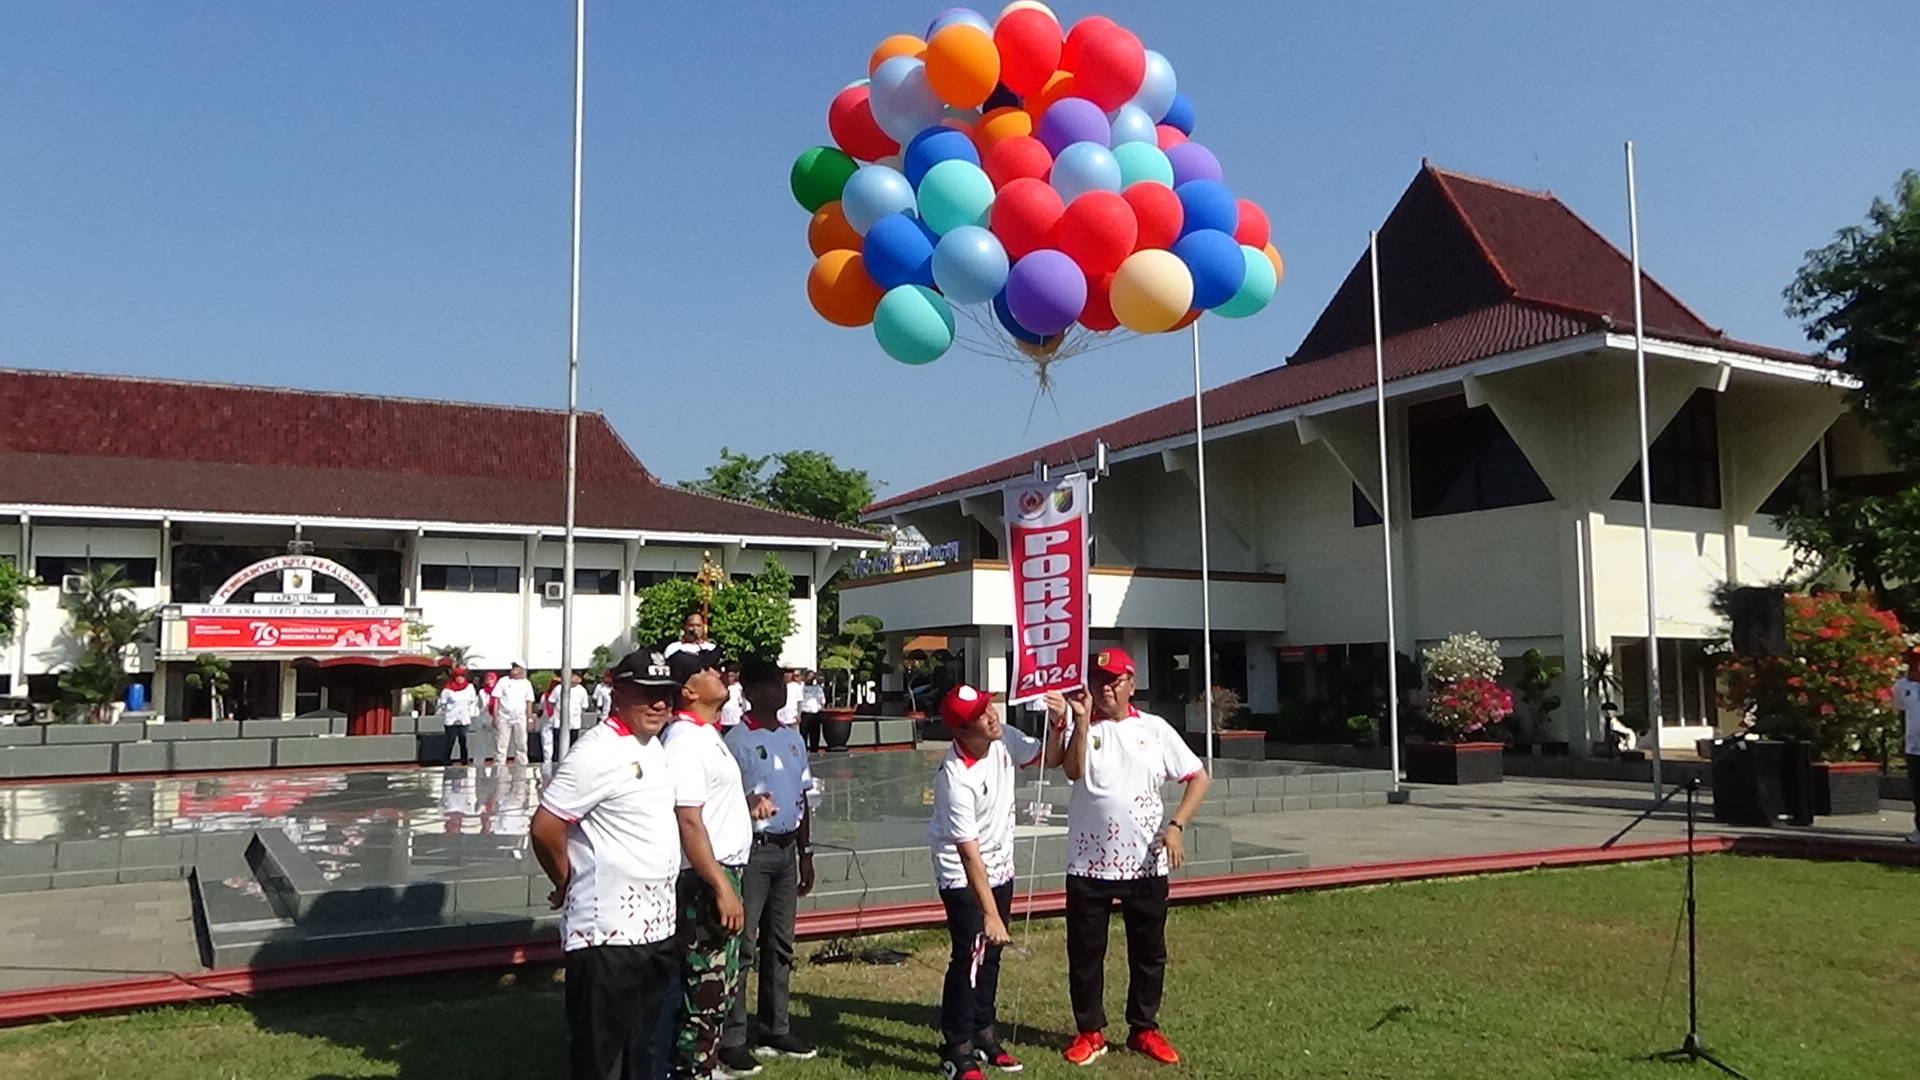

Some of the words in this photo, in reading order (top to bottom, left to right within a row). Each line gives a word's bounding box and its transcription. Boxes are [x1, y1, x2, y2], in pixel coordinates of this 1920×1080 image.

[219, 560, 280, 598] PEMERINTAH
[282, 557, 307, 567] KOTA
[311, 559, 370, 600] PEKALONGAN
[1021, 529, 1074, 667] PORKOT
[249, 621, 279, 646] 79
[1020, 663, 1078, 691] 2024
